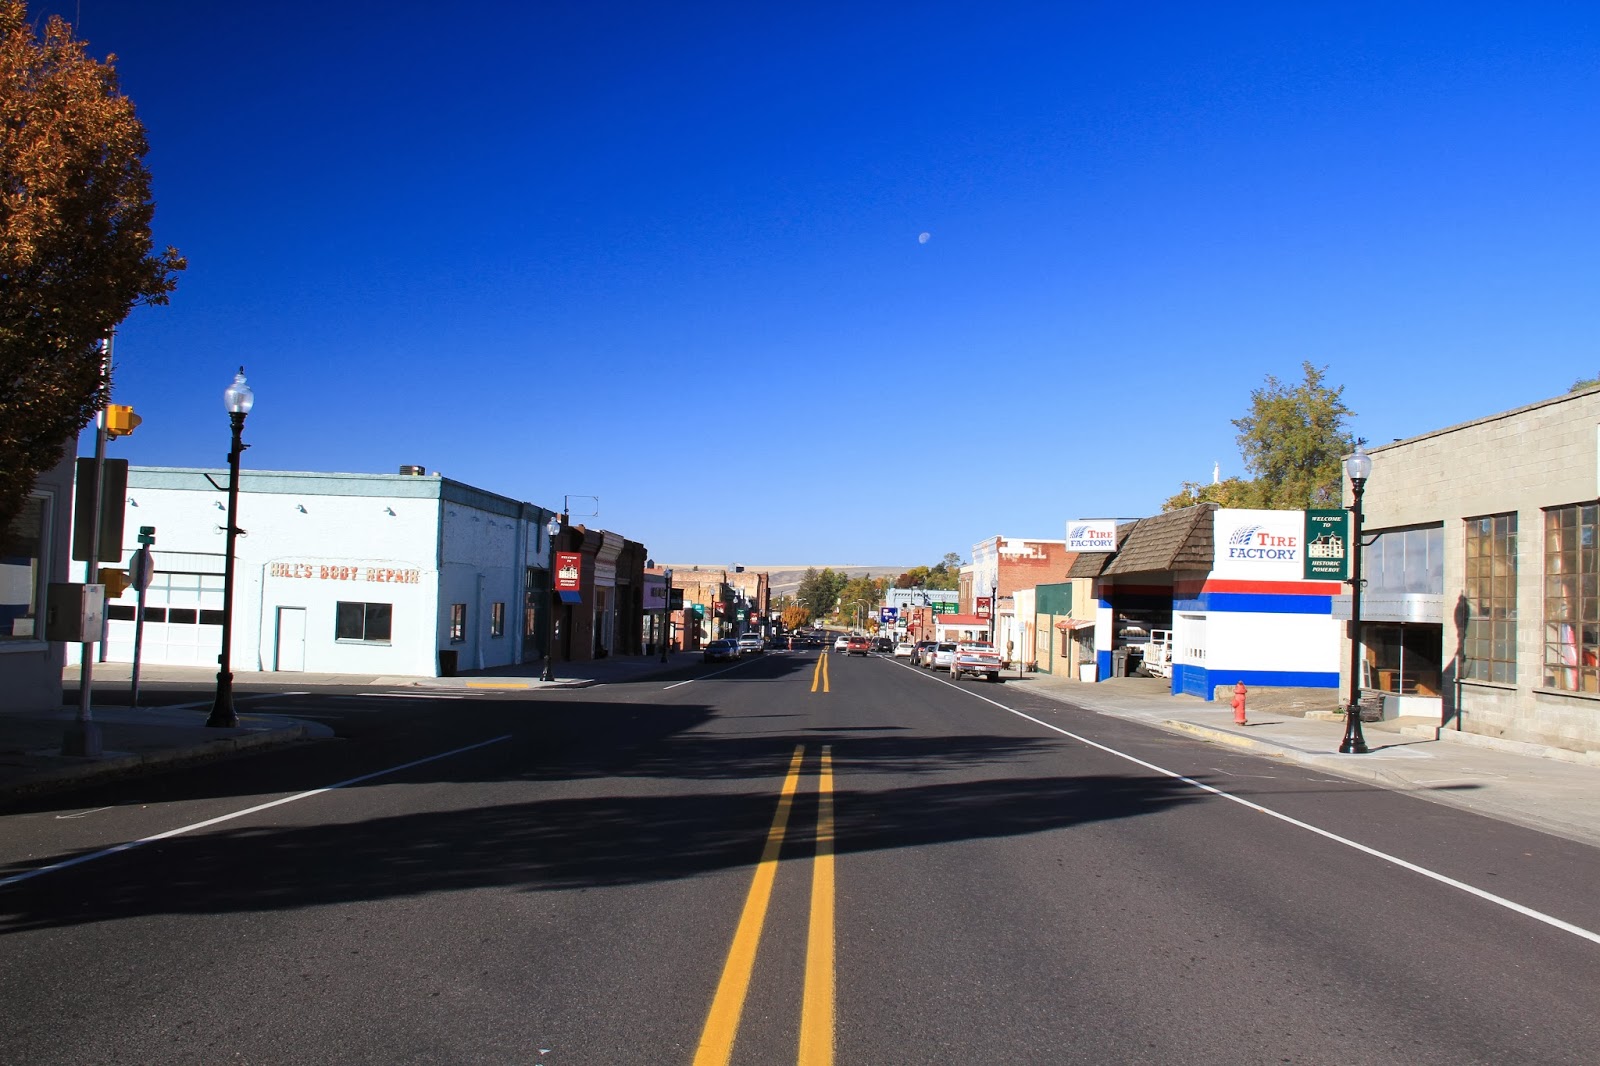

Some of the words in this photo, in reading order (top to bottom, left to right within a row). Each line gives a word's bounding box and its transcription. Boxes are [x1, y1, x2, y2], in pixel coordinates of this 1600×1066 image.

[1087, 530, 1113, 539] TIRE
[1257, 533, 1296, 547] TIRE
[1070, 539, 1113, 547] FACTORY
[1229, 548, 1296, 560] FACTORY
[270, 562, 313, 579] HILL'S
[320, 564, 358, 581] BODY
[366, 567, 420, 584] REPAIR
